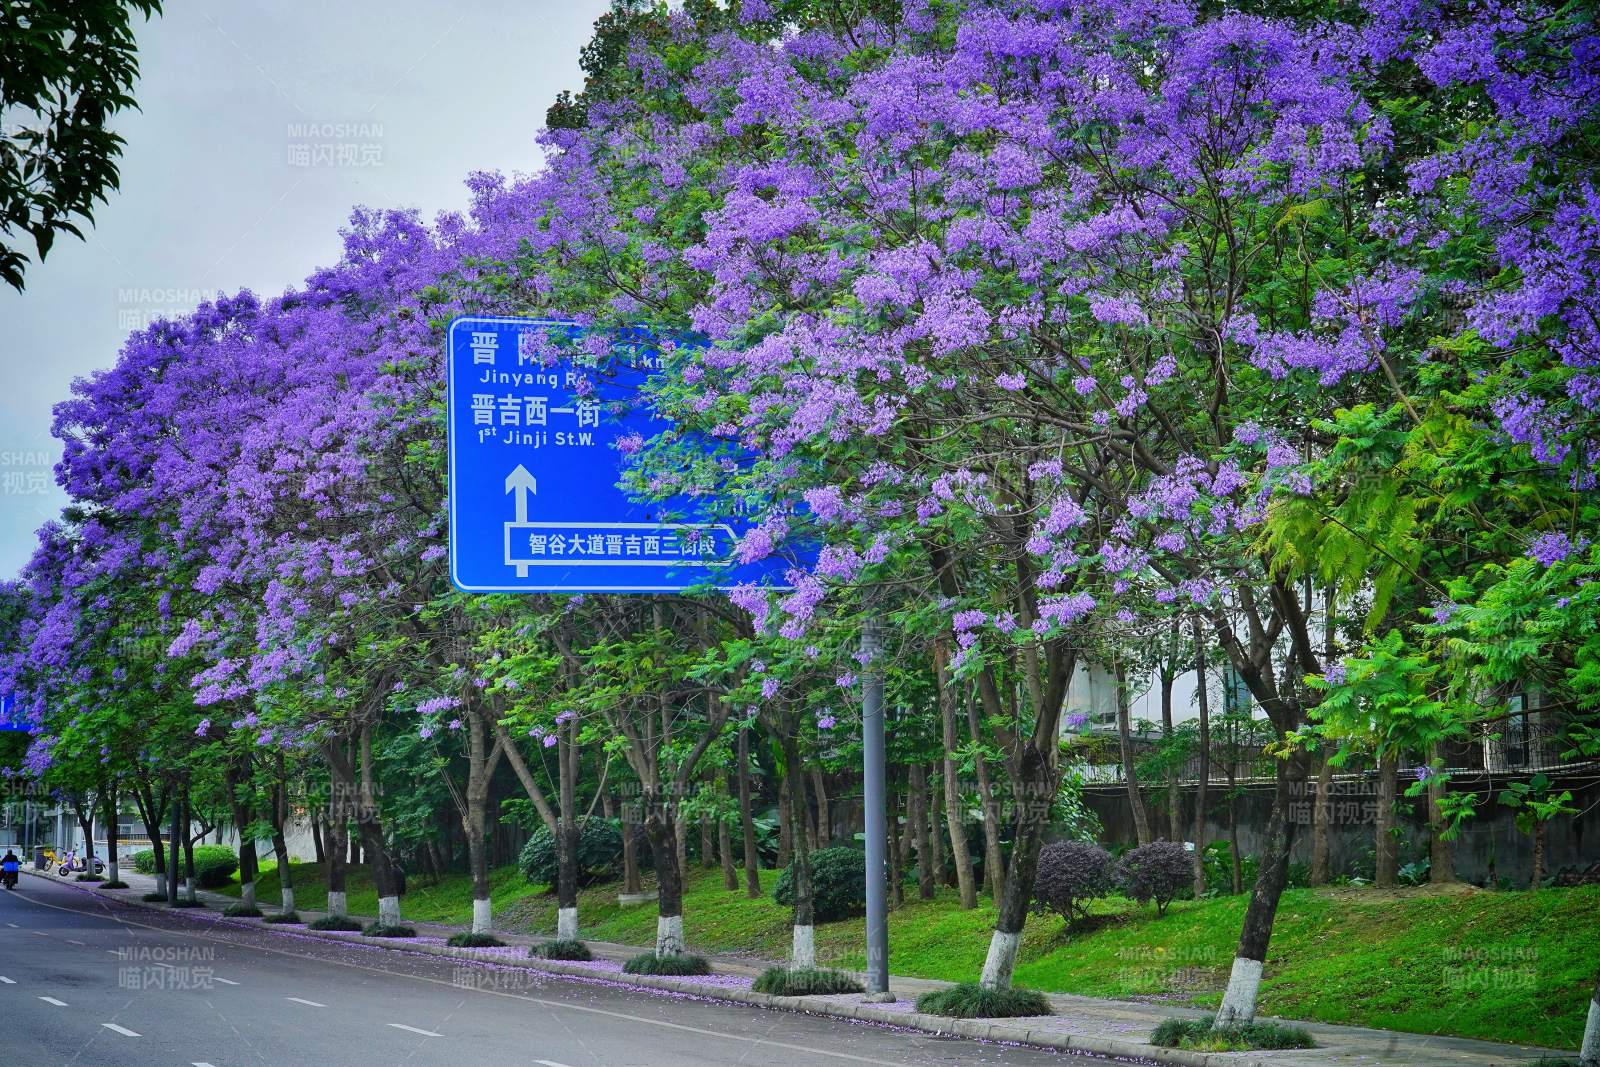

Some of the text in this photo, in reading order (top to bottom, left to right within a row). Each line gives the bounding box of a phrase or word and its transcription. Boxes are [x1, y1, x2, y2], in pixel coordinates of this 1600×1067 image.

[480, 370, 558, 387] Jinyang
[471, 394, 600, 428] 晋吉西一街
[503, 431, 547, 448] Jinji
[529, 533, 716, 556] 智谷大道晋吉西三街段
